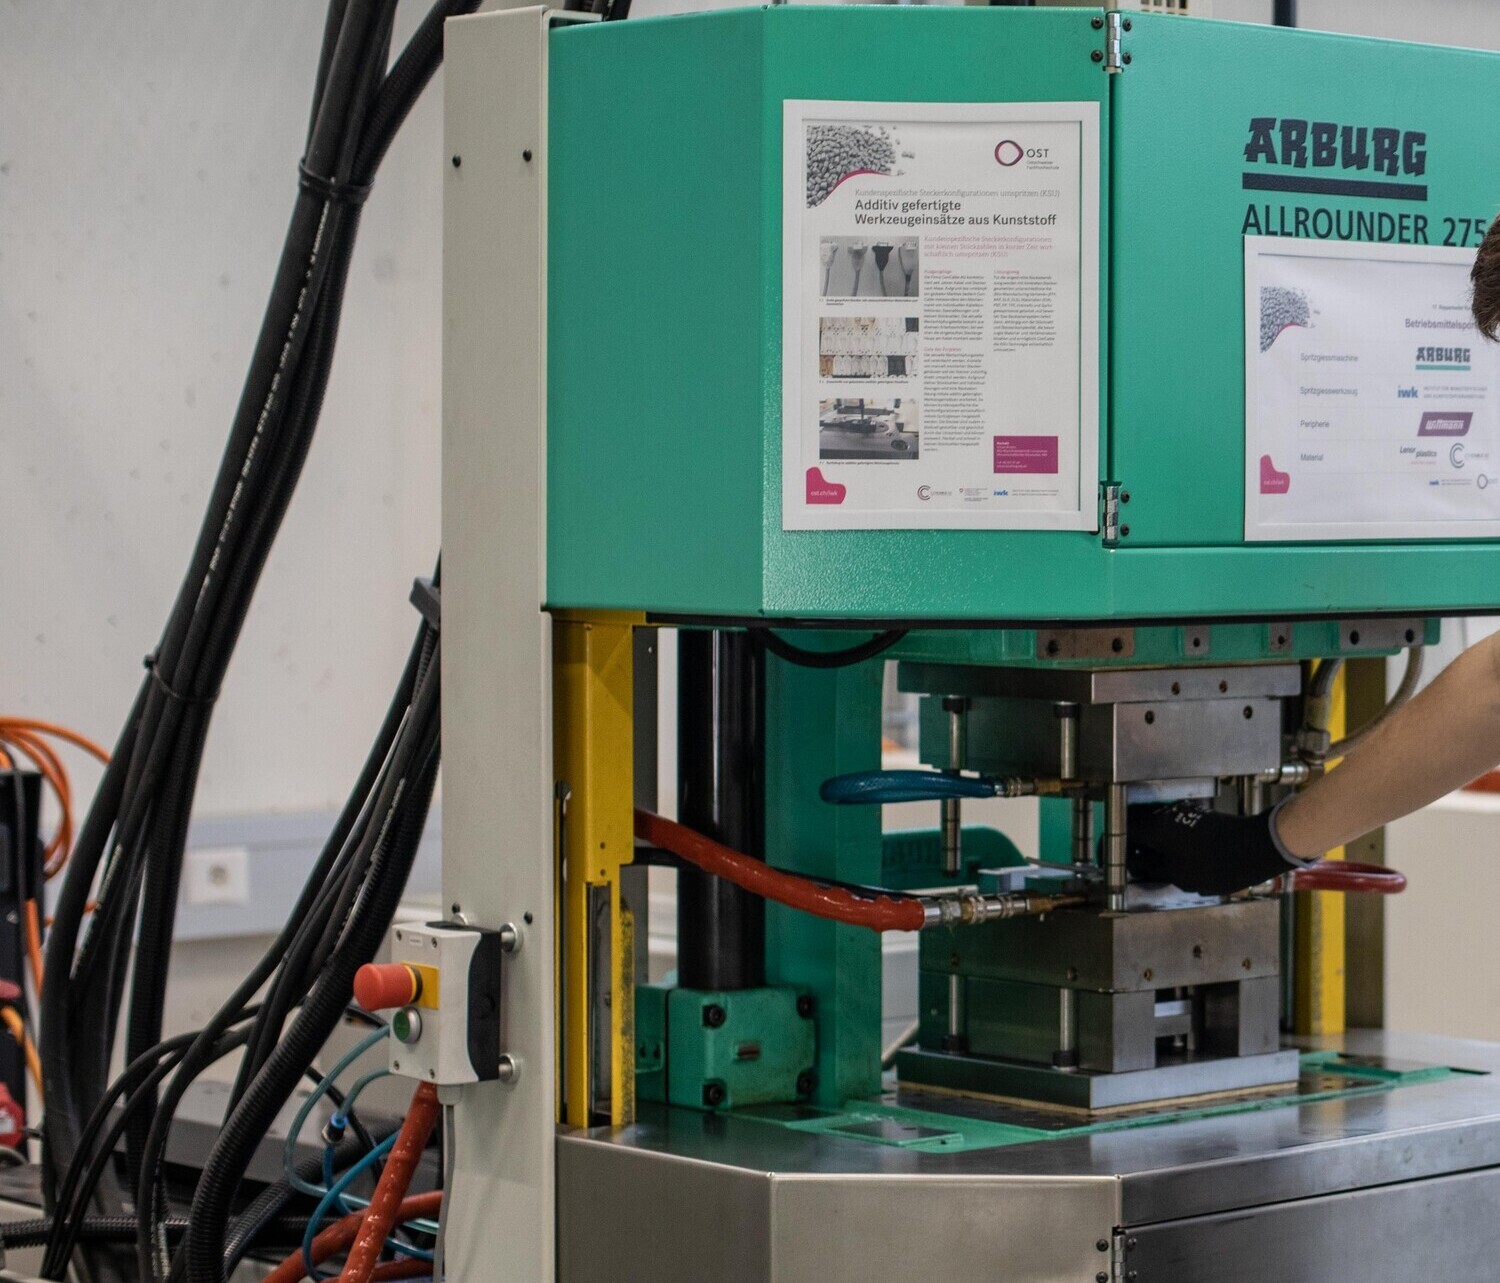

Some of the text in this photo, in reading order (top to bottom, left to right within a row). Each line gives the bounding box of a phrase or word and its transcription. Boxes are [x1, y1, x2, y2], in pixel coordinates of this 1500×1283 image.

[1026, 148, 1050, 158] OST
[1243, 117, 1427, 177] ARBURG
[855, 199, 961, 213] Additiv gefertigte
[855, 213, 1056, 227] Werkzeugeinsätze aus Kunststoff
[1241, 204, 1429, 244] ALLROUNDER
[1416, 346, 1471, 362] ARBURG
[1397, 385, 1418, 399] iwk
